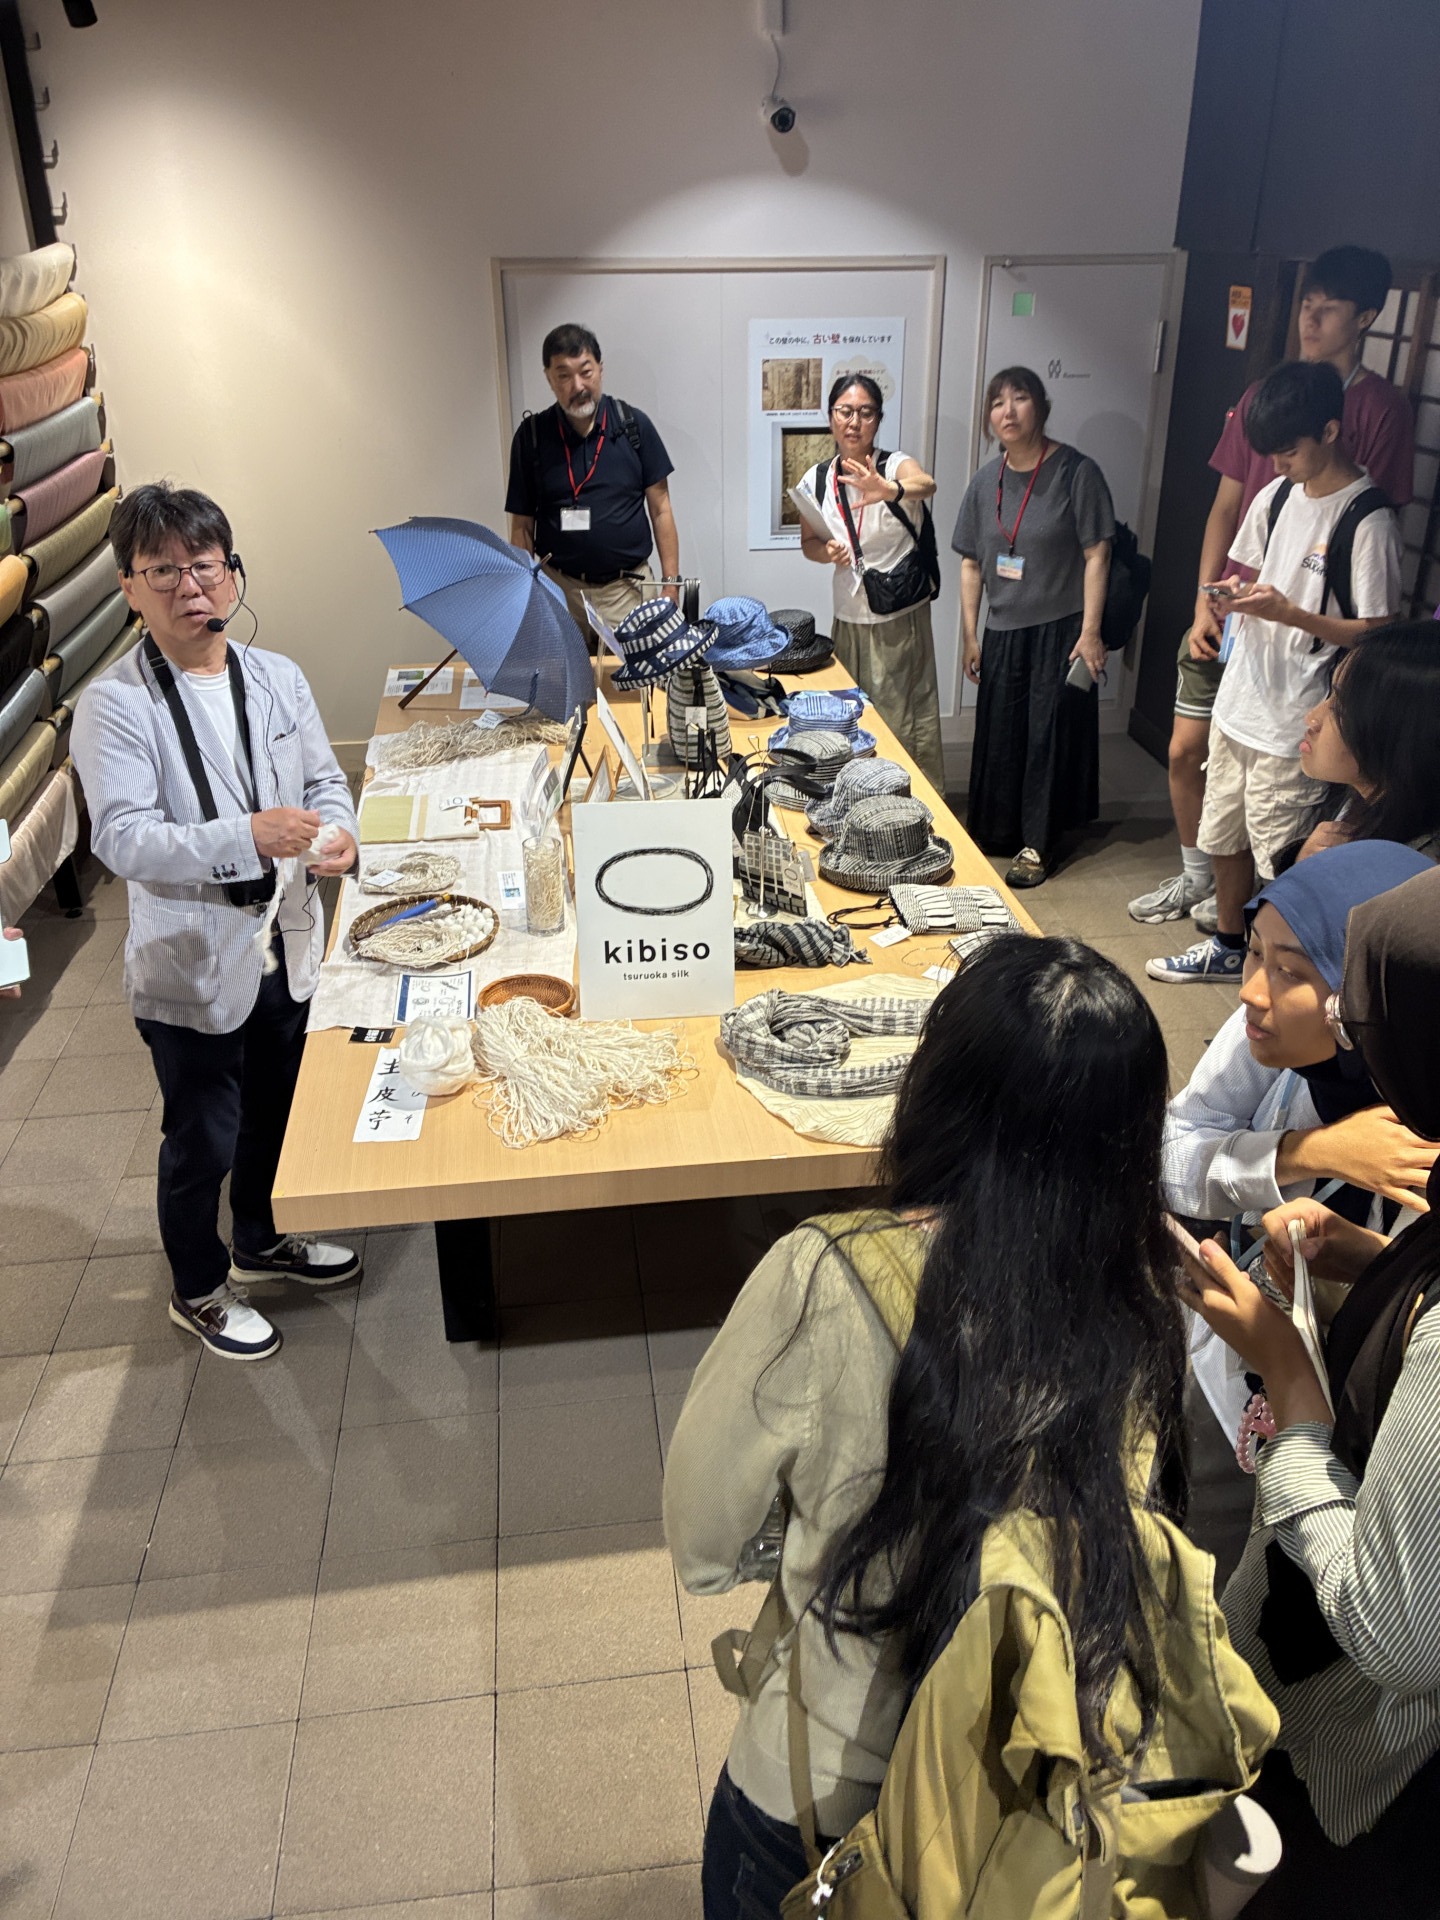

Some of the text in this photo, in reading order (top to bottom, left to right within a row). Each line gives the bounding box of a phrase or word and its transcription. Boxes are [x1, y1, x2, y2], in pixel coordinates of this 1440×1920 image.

[604, 938, 710, 964] kibiso
[623, 970, 690, 981] tsuruoka silk
